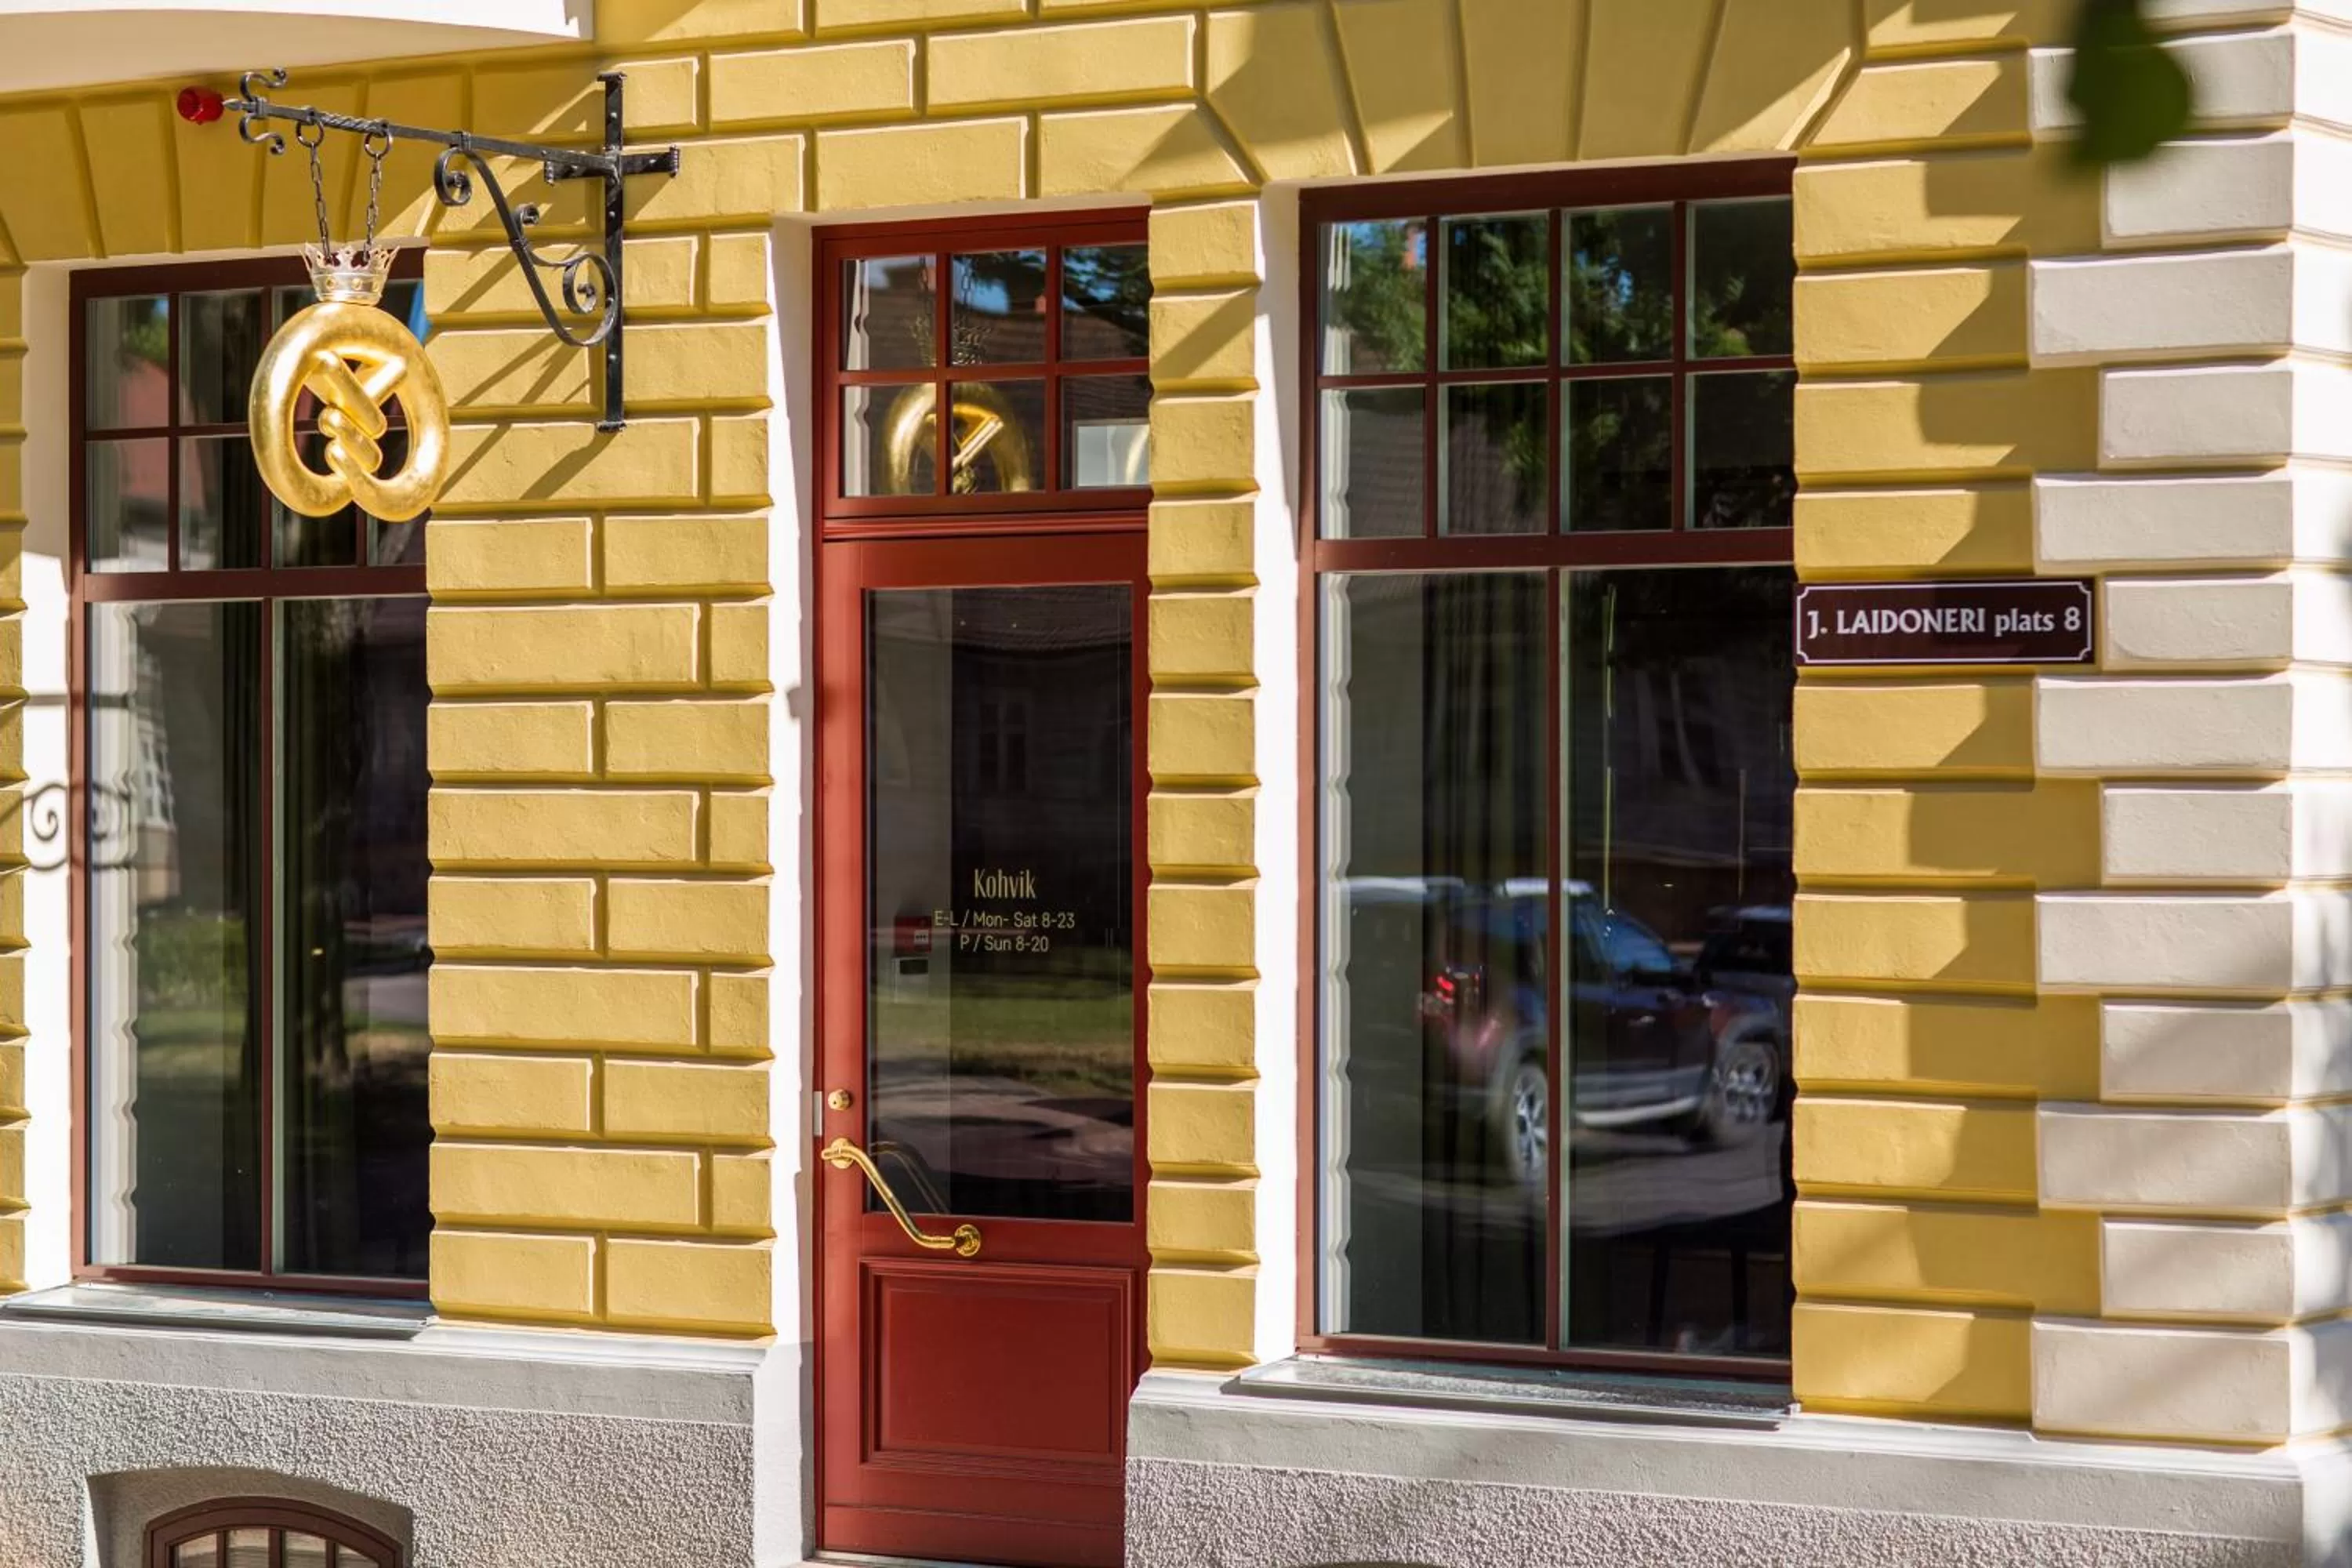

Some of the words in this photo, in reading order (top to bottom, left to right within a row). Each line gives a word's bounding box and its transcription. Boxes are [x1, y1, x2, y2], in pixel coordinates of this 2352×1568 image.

[1807, 611, 1828, 638] J.
[1836, 608, 1985, 635] LAIDONERI
[1994, 608, 2054, 637] plats
[2064, 607, 2081, 631] 8
[974, 868, 1037, 899] Kohvik
[934, 910, 959, 926] E-L
[962, 909, 970, 927] /
[972, 912, 1010, 927] Mon-
[1013, 912, 1039, 928] Sat
[1041, 912, 1076, 929] 8-23
[960, 935, 970, 950] P
[972, 934, 981, 953] /
[984, 935, 1012, 952] Sun
[1015, 935, 1049, 953] 8-20
